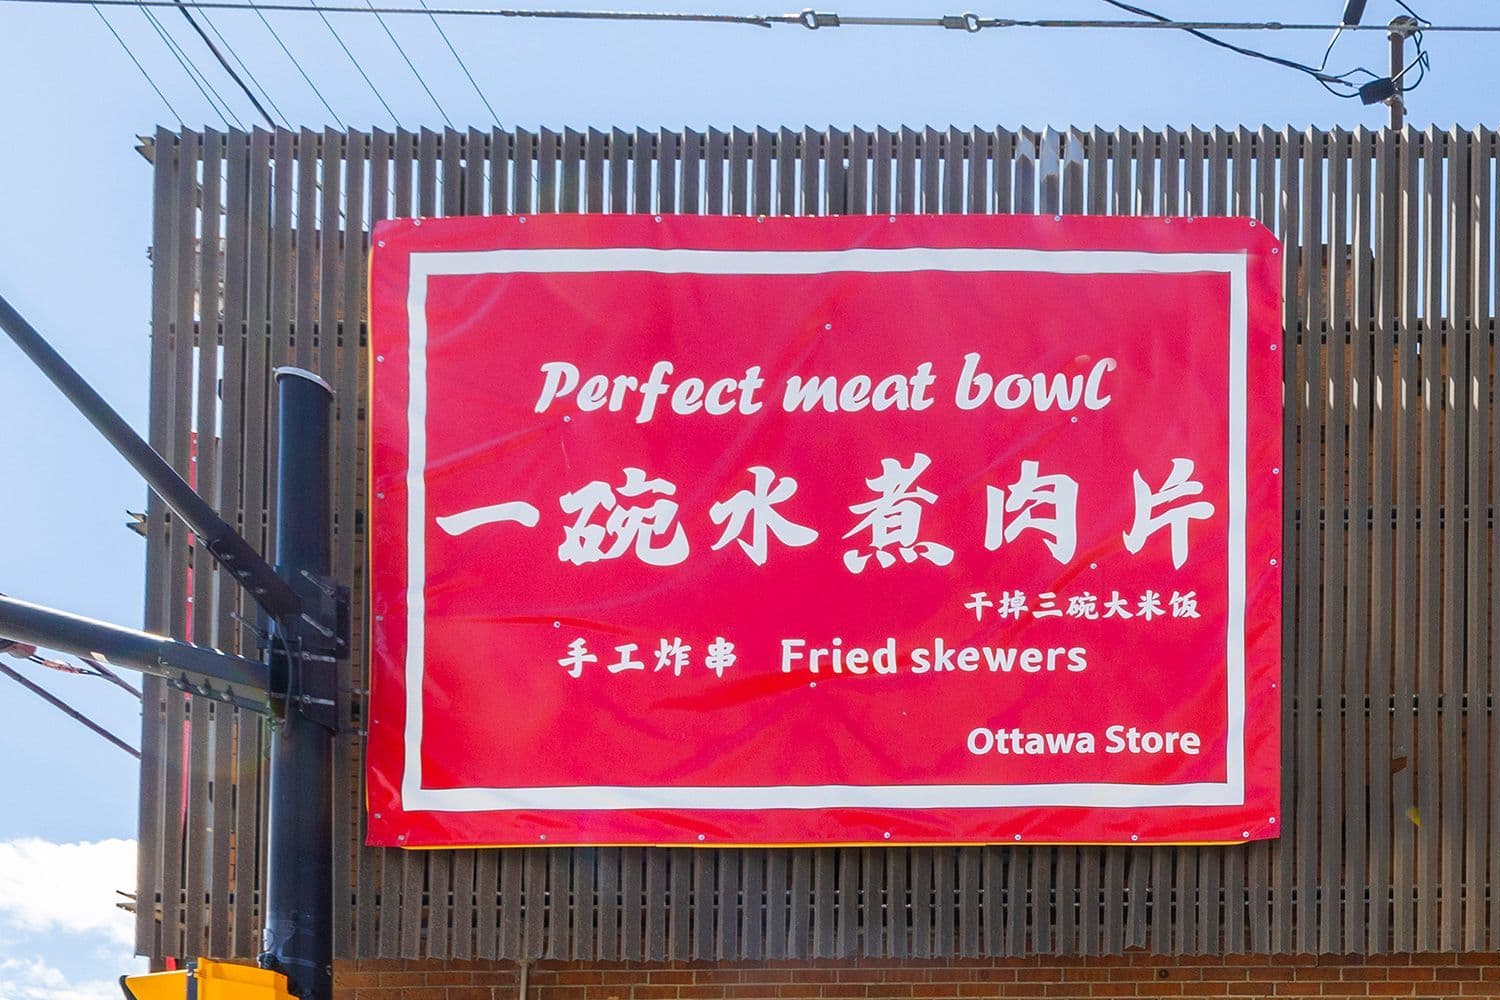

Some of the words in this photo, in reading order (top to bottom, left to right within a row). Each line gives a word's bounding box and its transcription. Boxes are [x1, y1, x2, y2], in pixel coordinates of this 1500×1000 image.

[535, 361, 764, 423] Perfect
[783, 362, 936, 412] meat
[955, 352, 1116, 411] bowl
[436, 453, 1215, 573] 一碗水煮肉片
[964, 590, 1201, 621] 干掉三碗大米饭
[558, 637, 736, 678] 手工炸串
[782, 638, 897, 674] Fried
[911, 638, 1087, 673] skewers
[967, 728, 1094, 754] Ottawa
[1106, 725, 1200, 754] Store
